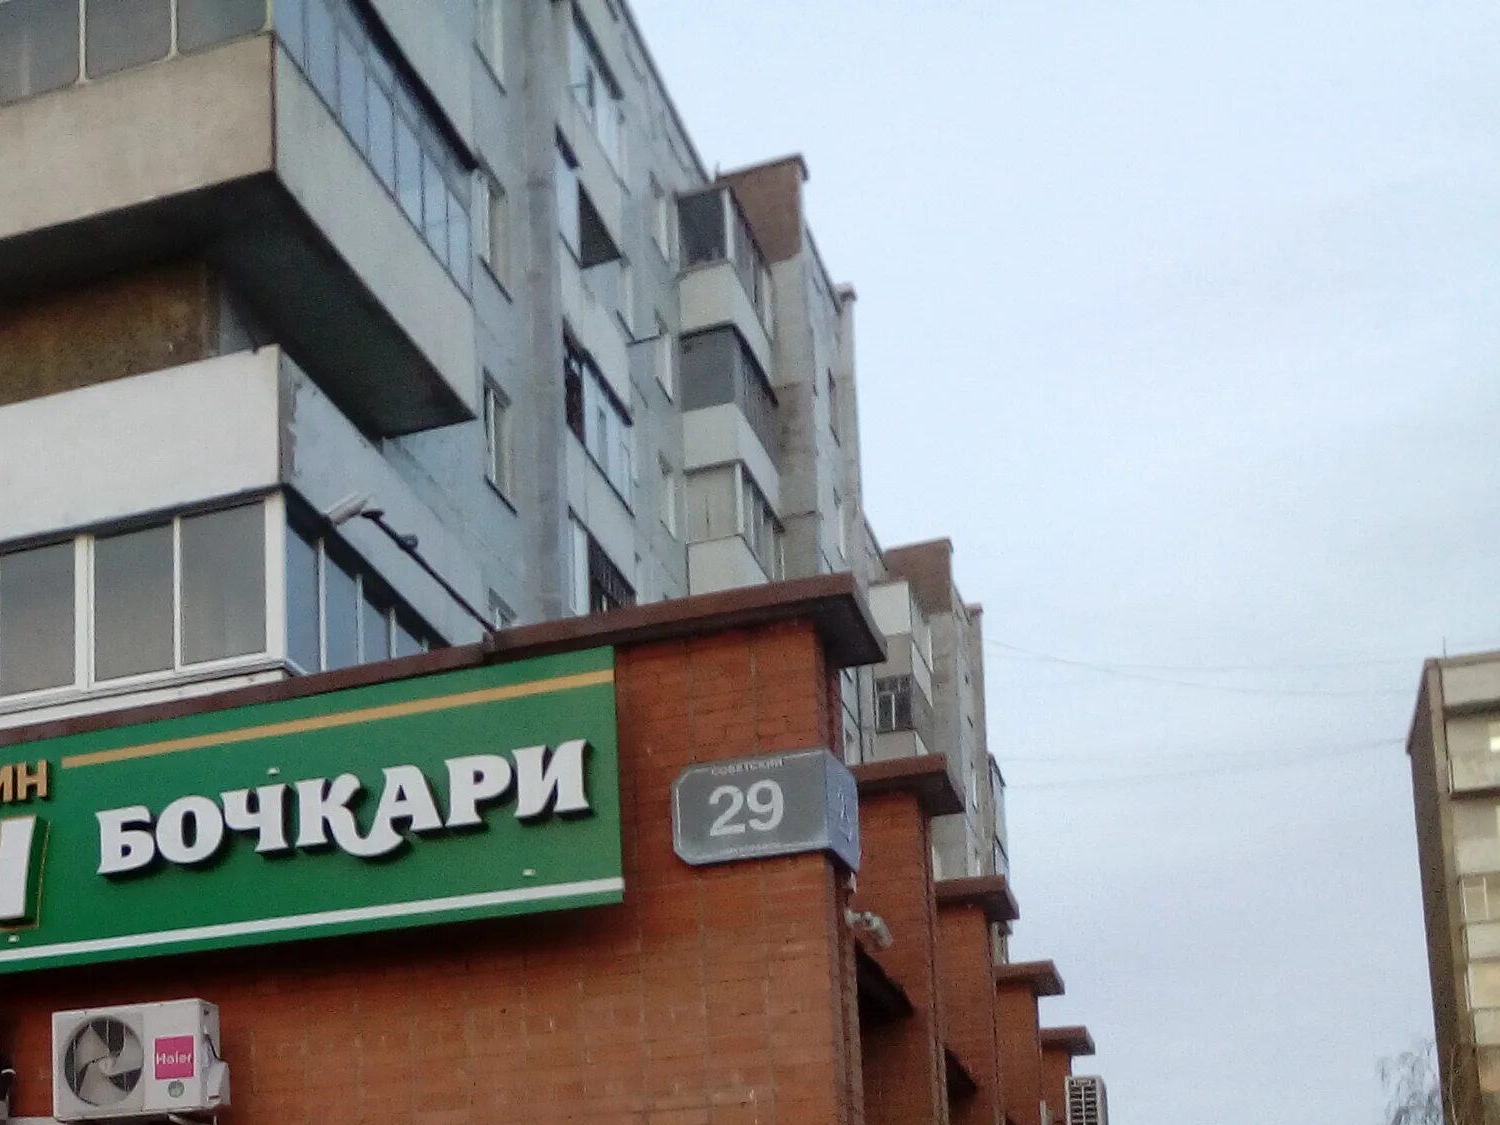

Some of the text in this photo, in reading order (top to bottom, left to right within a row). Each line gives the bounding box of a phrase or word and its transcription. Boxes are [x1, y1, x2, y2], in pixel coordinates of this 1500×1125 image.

[96, 738, 591, 877] БОЧКАРИ
[709, 779, 784, 837] 29
[156, 1050, 193, 1065] Haier
